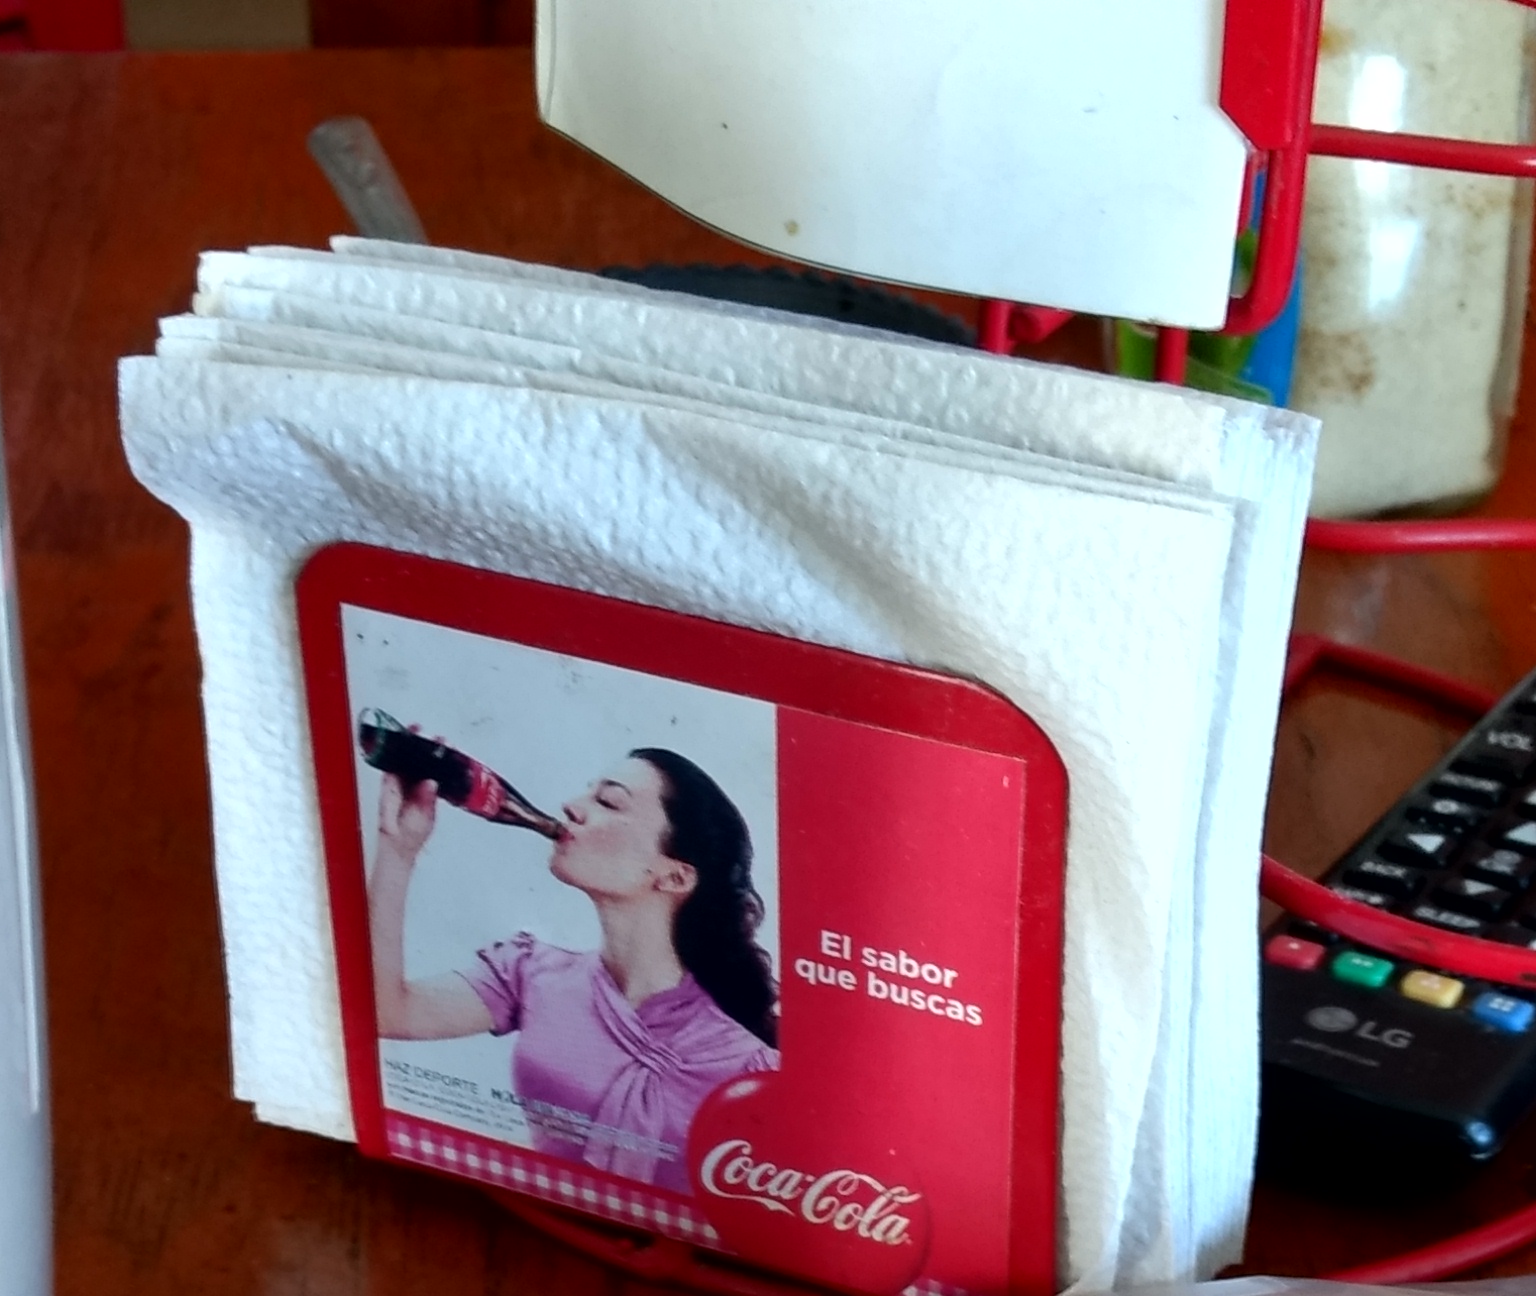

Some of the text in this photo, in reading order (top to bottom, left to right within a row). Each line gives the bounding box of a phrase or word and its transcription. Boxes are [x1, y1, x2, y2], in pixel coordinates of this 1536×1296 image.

[1487, 730, 1535, 751] VOL
[1414, 906, 1481, 928] SLEEP
[820, 929, 959, 988] El sabor
[794, 957, 983, 1026] que buscas
[1356, 1021, 1415, 1048] LG
[413, 1066, 479, 1096] DEPORTE
[700, 1138, 922, 1246] Coca-Cola
